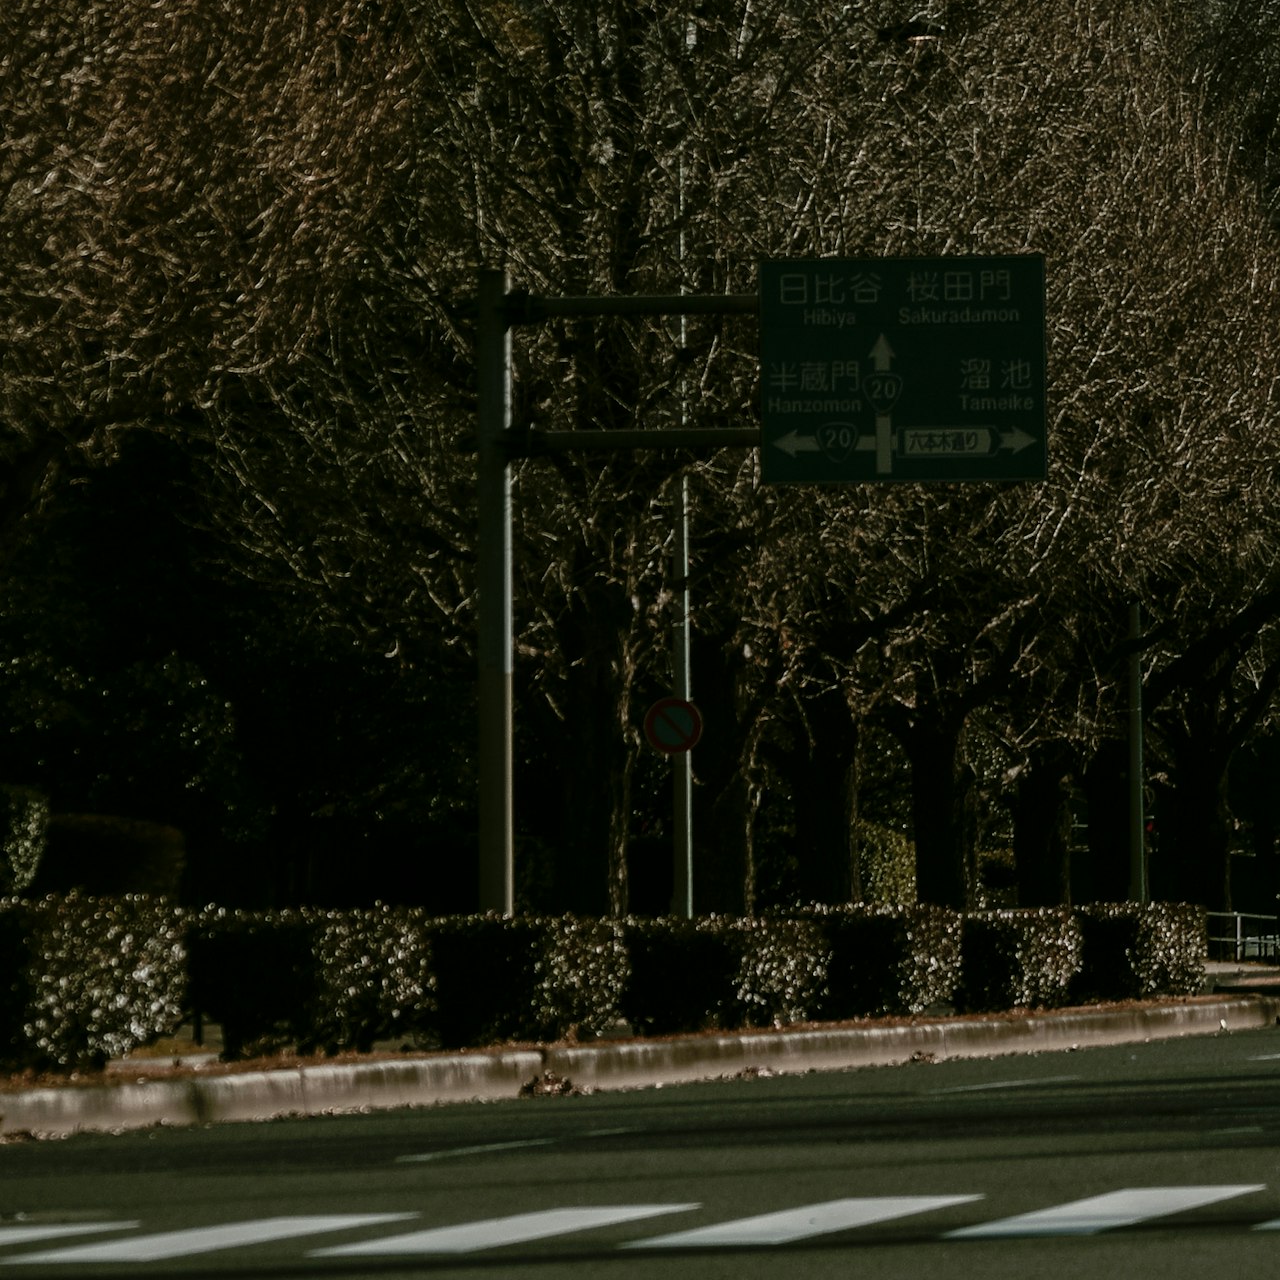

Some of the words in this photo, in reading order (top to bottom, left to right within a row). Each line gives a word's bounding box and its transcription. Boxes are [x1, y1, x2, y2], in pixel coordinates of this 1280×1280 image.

[779, 272, 882, 305] 日比谷
[906, 269, 1011, 302] 桜田門
[803, 308, 857, 329] Hibiya
[898, 306, 1020, 325] Sakuradamon
[769, 360, 861, 393] 半蔵門
[959, 358, 1033, 390] 溜池
[871, 379, 896, 400] 20
[767, 395, 863, 413] Hanzomon
[959, 394, 1035, 411] Tameike
[825, 427, 851, 448] 20
[909, 430, 979, 451] 六本木通り
